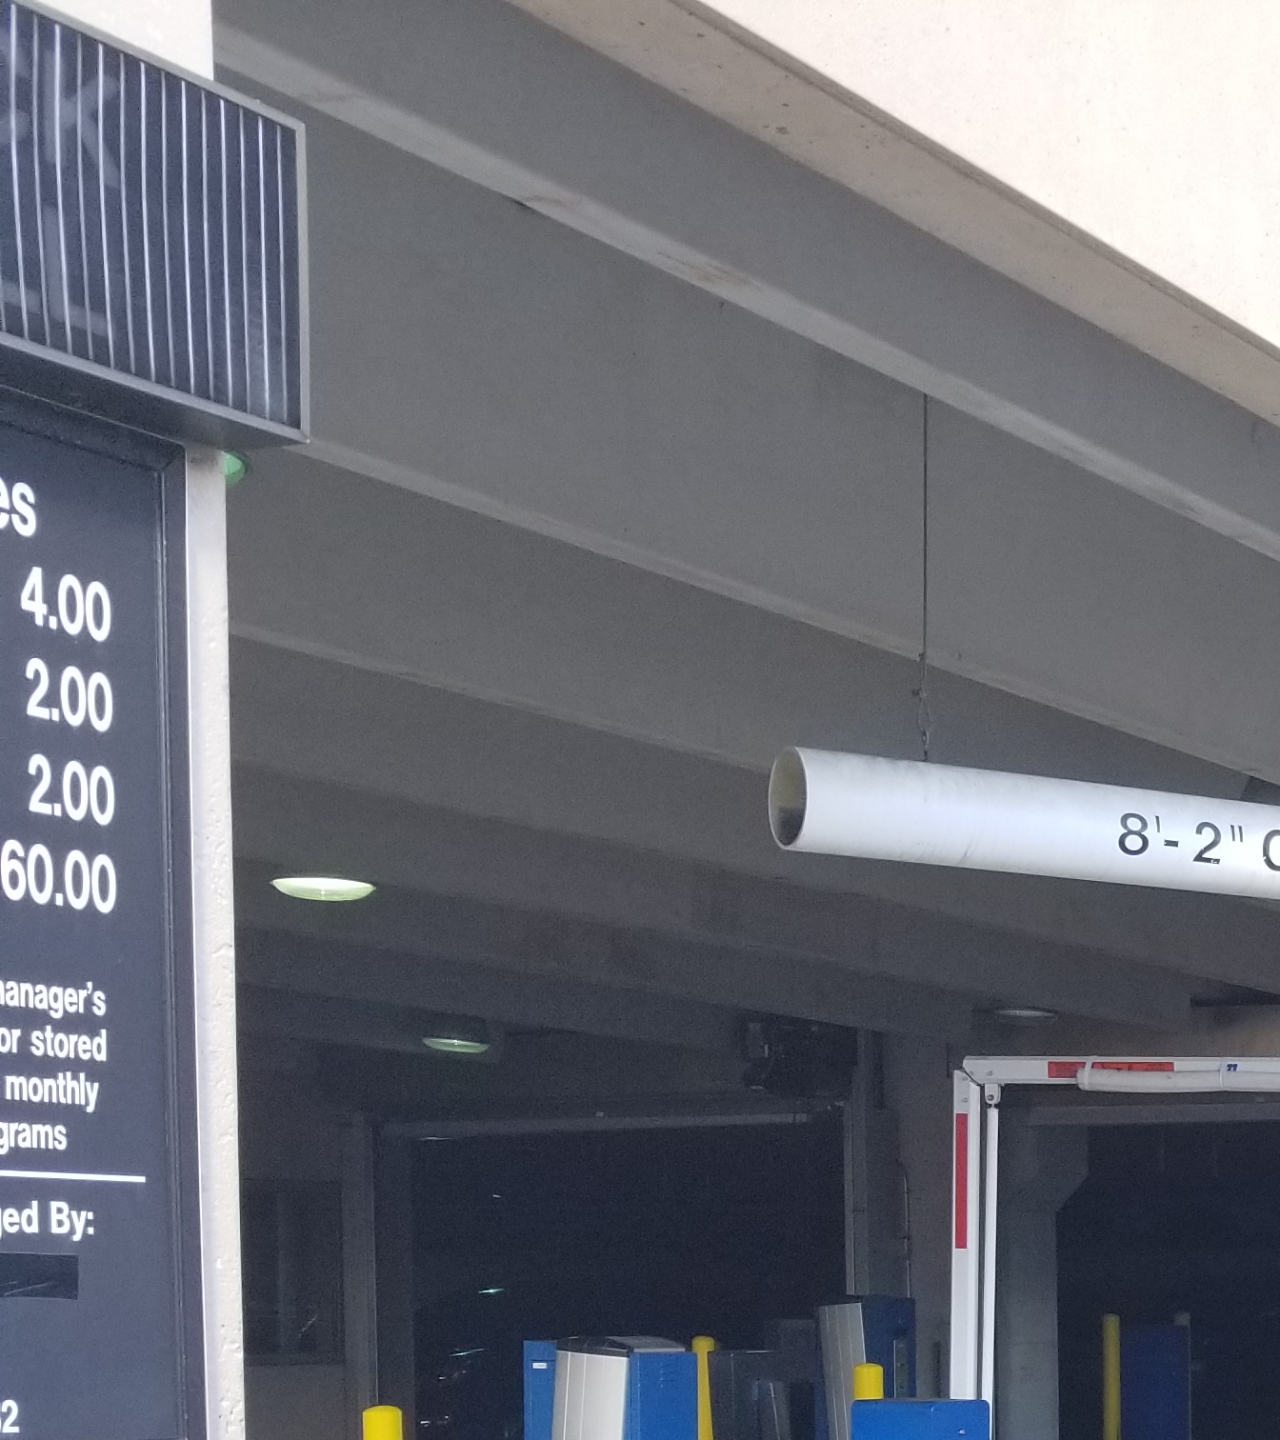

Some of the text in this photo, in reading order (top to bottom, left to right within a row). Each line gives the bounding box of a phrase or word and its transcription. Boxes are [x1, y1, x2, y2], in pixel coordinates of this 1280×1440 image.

[20, 566, 112, 642] 4.00
[25, 658, 114, 733] 2.00
[28, 754, 116, 826] 2.00
[0, 839, 117, 914] 60.00
[0, 980, 106, 1019] anager's
[30, 1025, 107, 1061] stored
[4, 1071, 99, 1113] monthly
[0, 1200, 95, 1242] ed By:
[0, 1399, 20, 1433] 2
